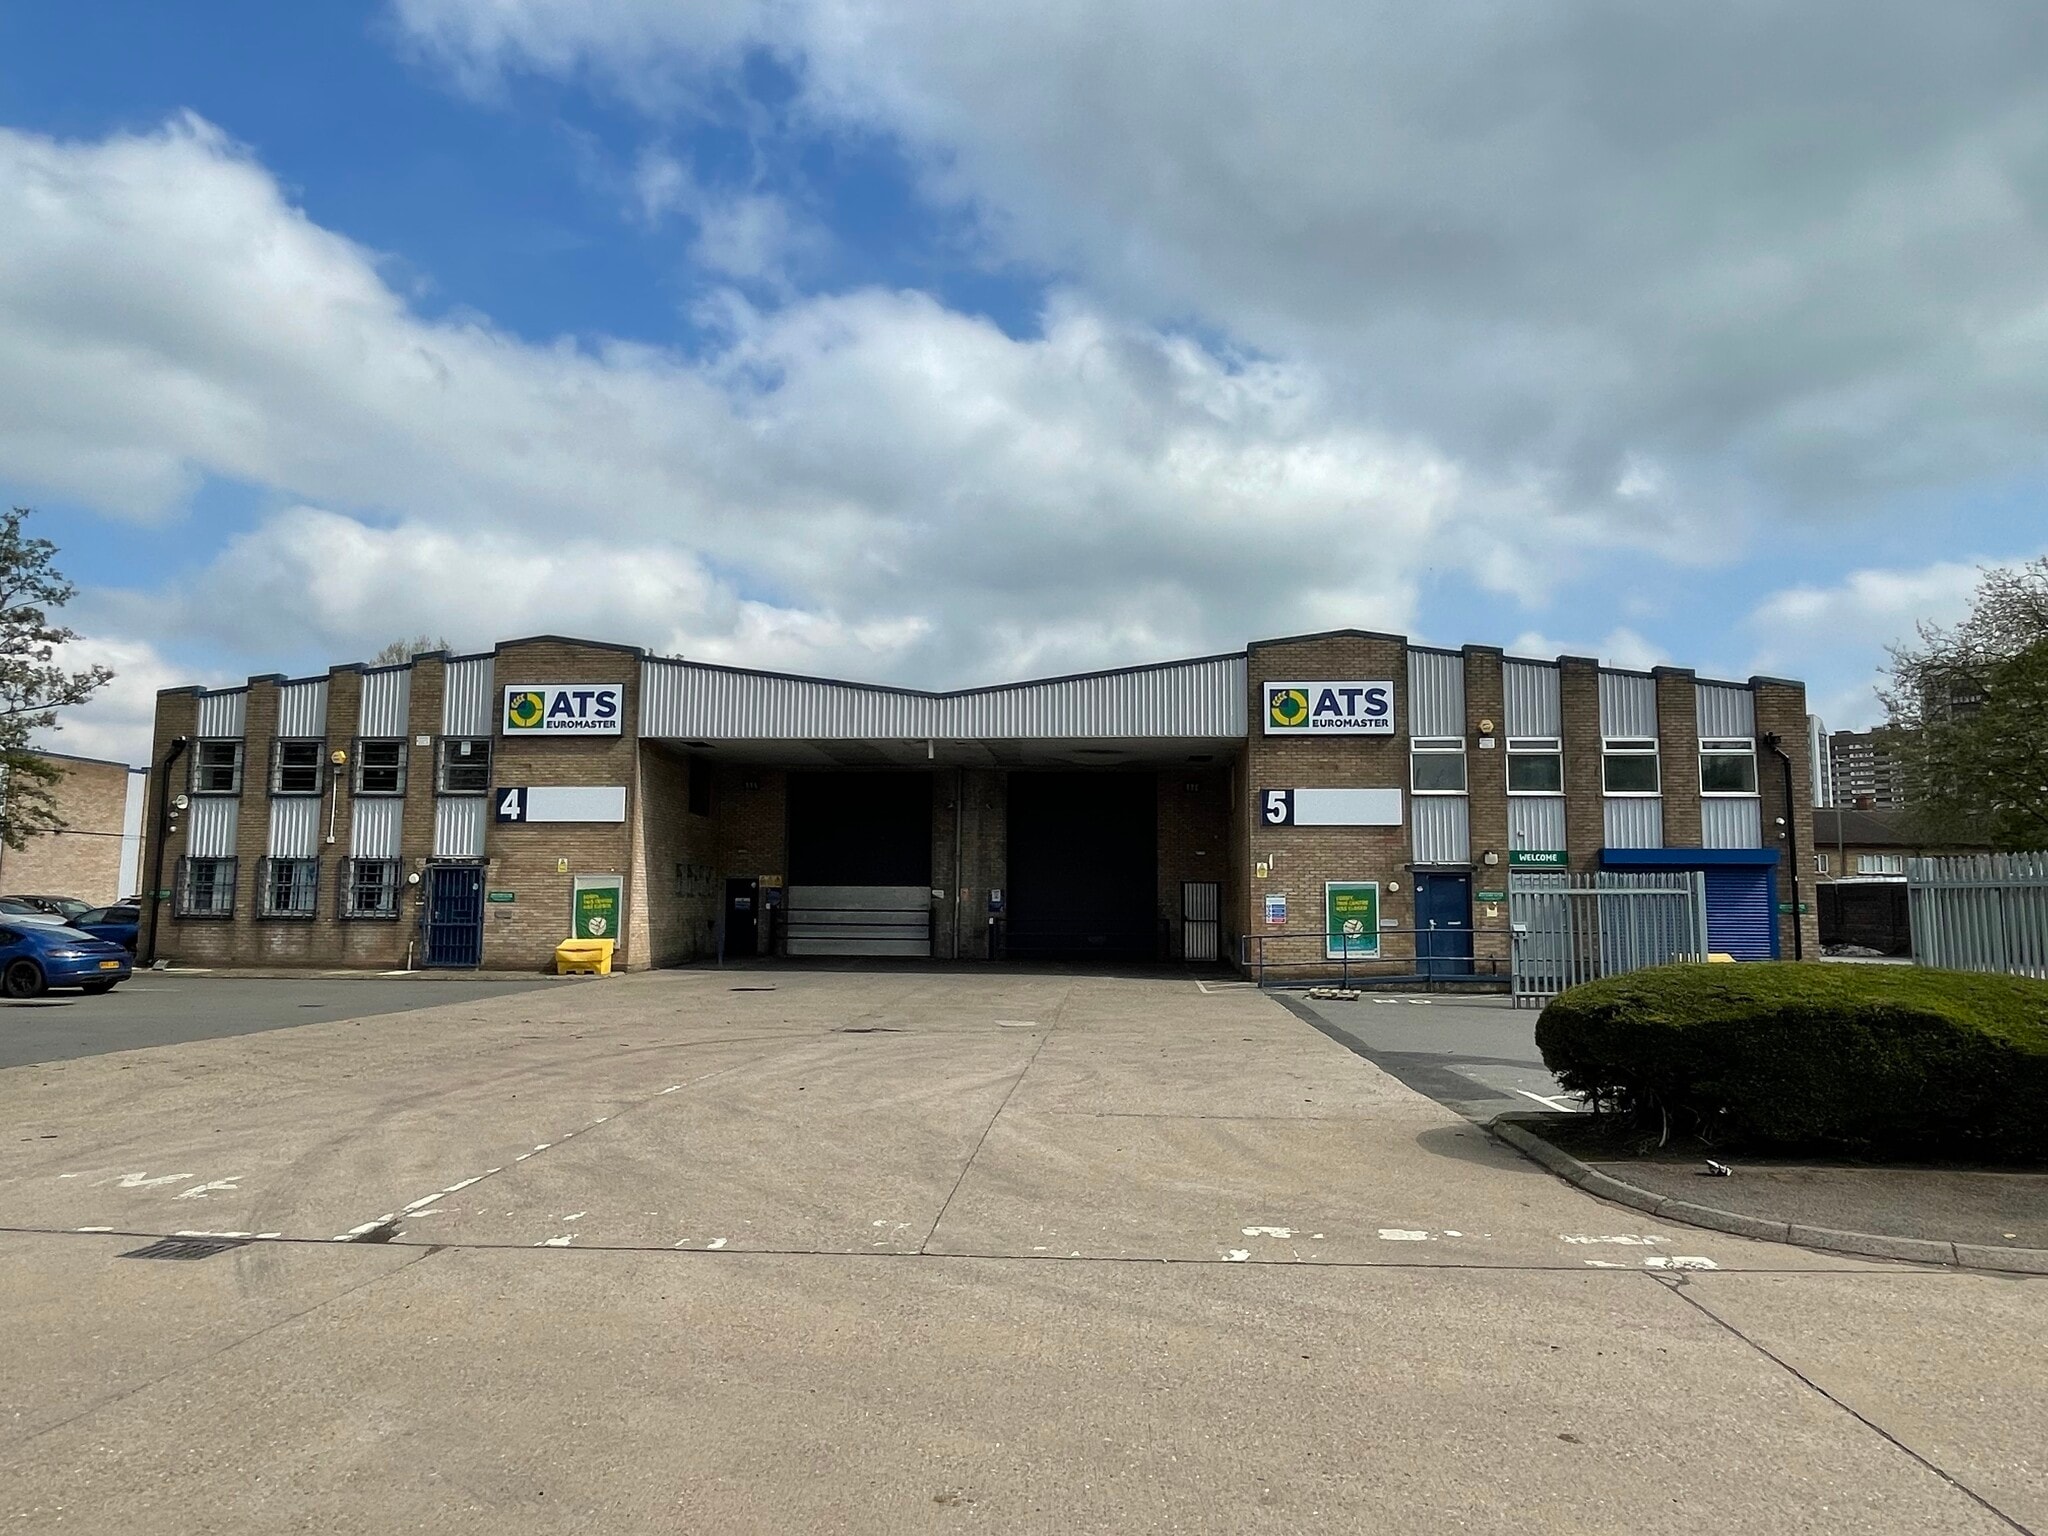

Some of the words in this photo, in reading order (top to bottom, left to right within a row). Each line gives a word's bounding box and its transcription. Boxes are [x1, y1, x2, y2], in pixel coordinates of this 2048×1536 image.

[547, 691, 617, 718] ATS
[1312, 688, 1388, 717] ATS
[546, 720, 616, 729] EUROMASTER
[1312, 719, 1389, 728] EUROMASTER
[500, 788, 520, 820] 4
[1266, 790, 1287, 824] 5
[1519, 853, 1558, 862] WELCOME
